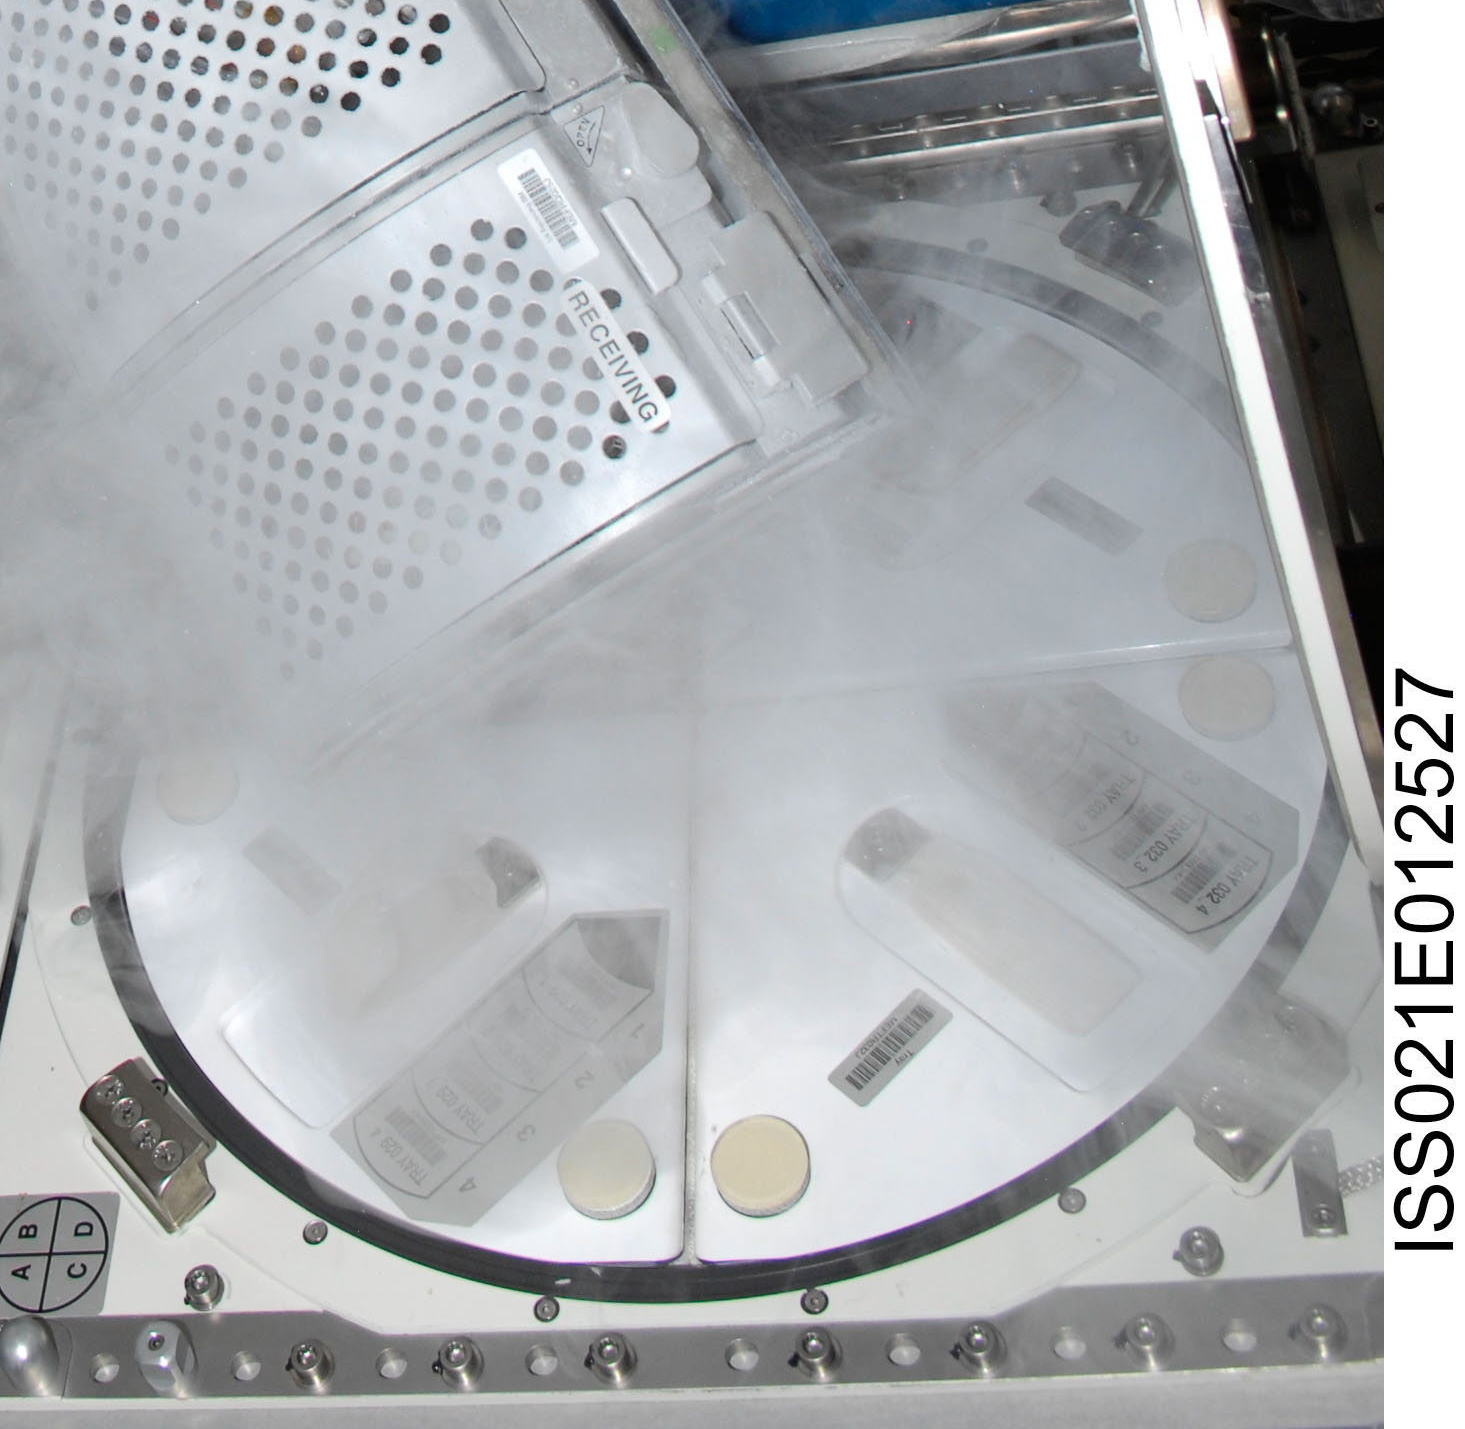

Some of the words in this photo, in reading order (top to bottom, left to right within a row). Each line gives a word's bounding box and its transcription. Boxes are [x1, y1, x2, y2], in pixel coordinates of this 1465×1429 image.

[575, 117, 589, 146] OPEN
[566, 288, 661, 423] RECEIVING
[1119, 728, 1140, 745] 2
[1160, 812, 1194, 849] TRAY
[1225, 852, 1257, 887] TRAY
[893, 1048, 913, 1067] Tray
[575, 1072, 595, 1089] 2
[455, 1100, 484, 1134] TRAY
[516, 1125, 537, 1144] 3
[397, 1151, 430, 1187] TRAY
[459, 1177, 478, 1194] 4
[19, 1223, 37, 1240] B
[75, 1222, 93, 1238] D
[13, 1263, 31, 1281] A
[68, 1263, 86, 1280] C
